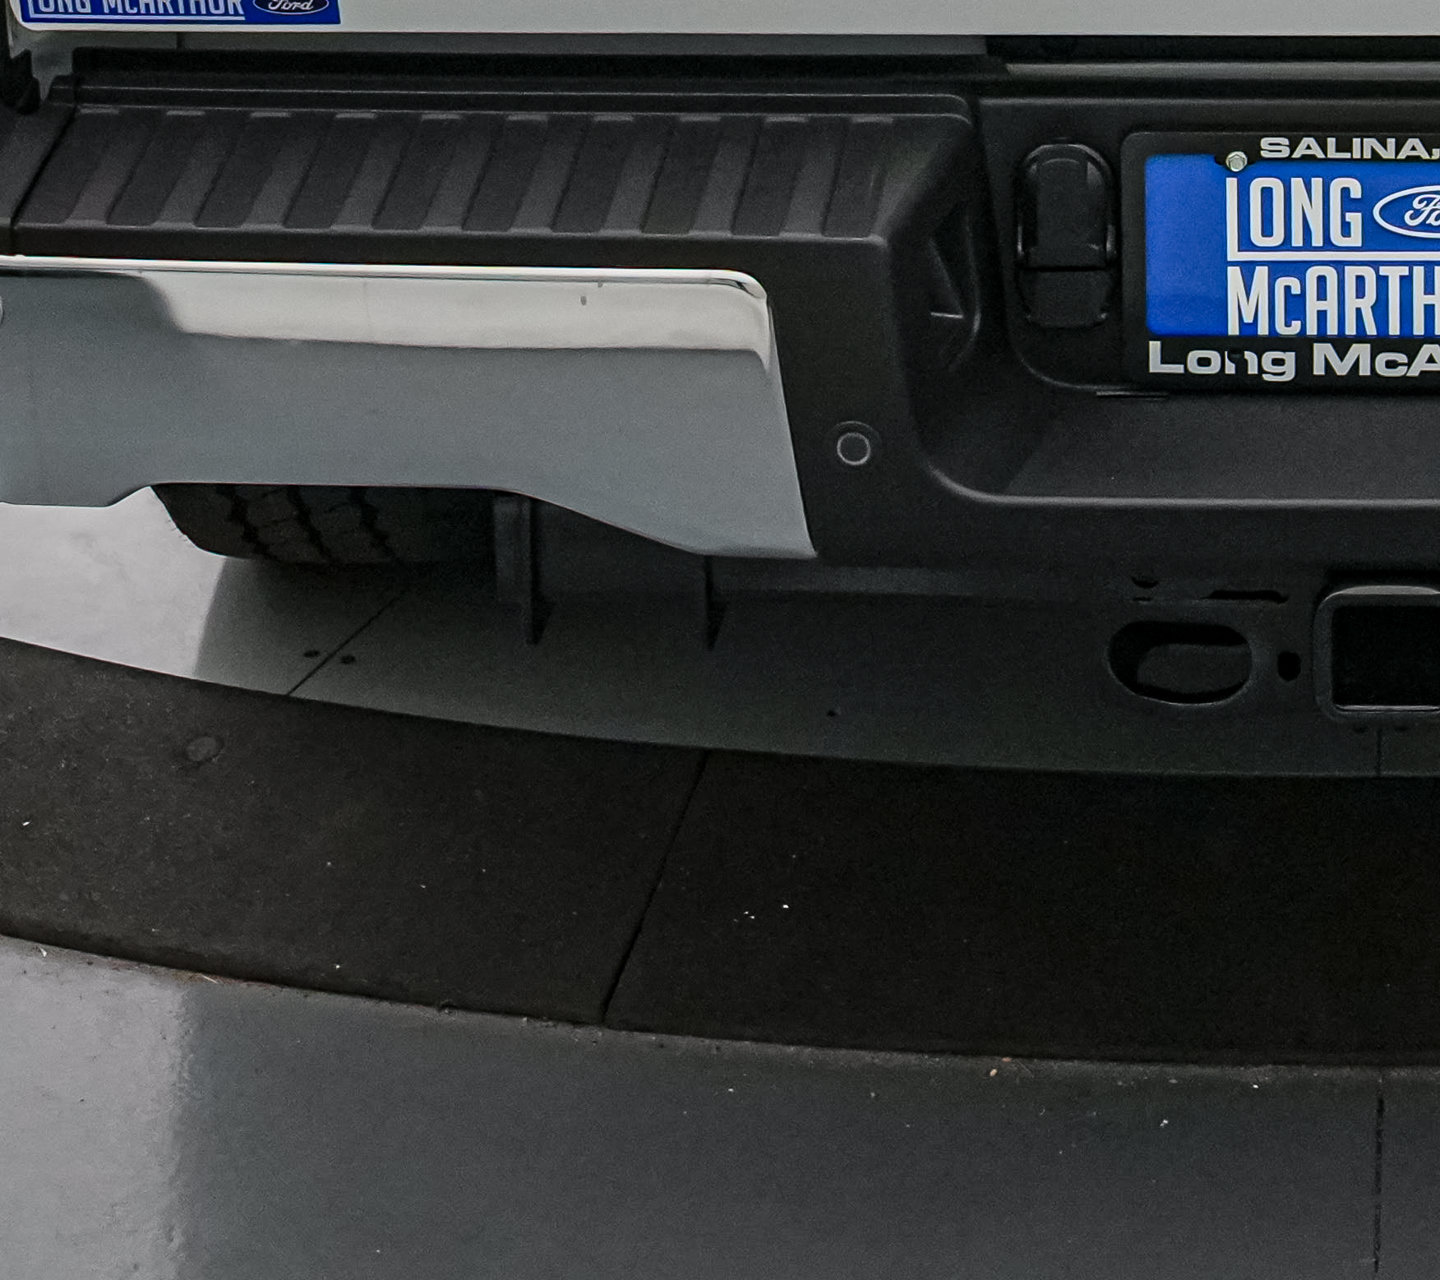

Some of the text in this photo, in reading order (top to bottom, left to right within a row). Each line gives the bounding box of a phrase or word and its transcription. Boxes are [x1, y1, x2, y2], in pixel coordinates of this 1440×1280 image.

[1259, 136, 1440, 162] SALINA,
[1225, 176, 1364, 255] LONG
[1148, 340, 1296, 382] Long
